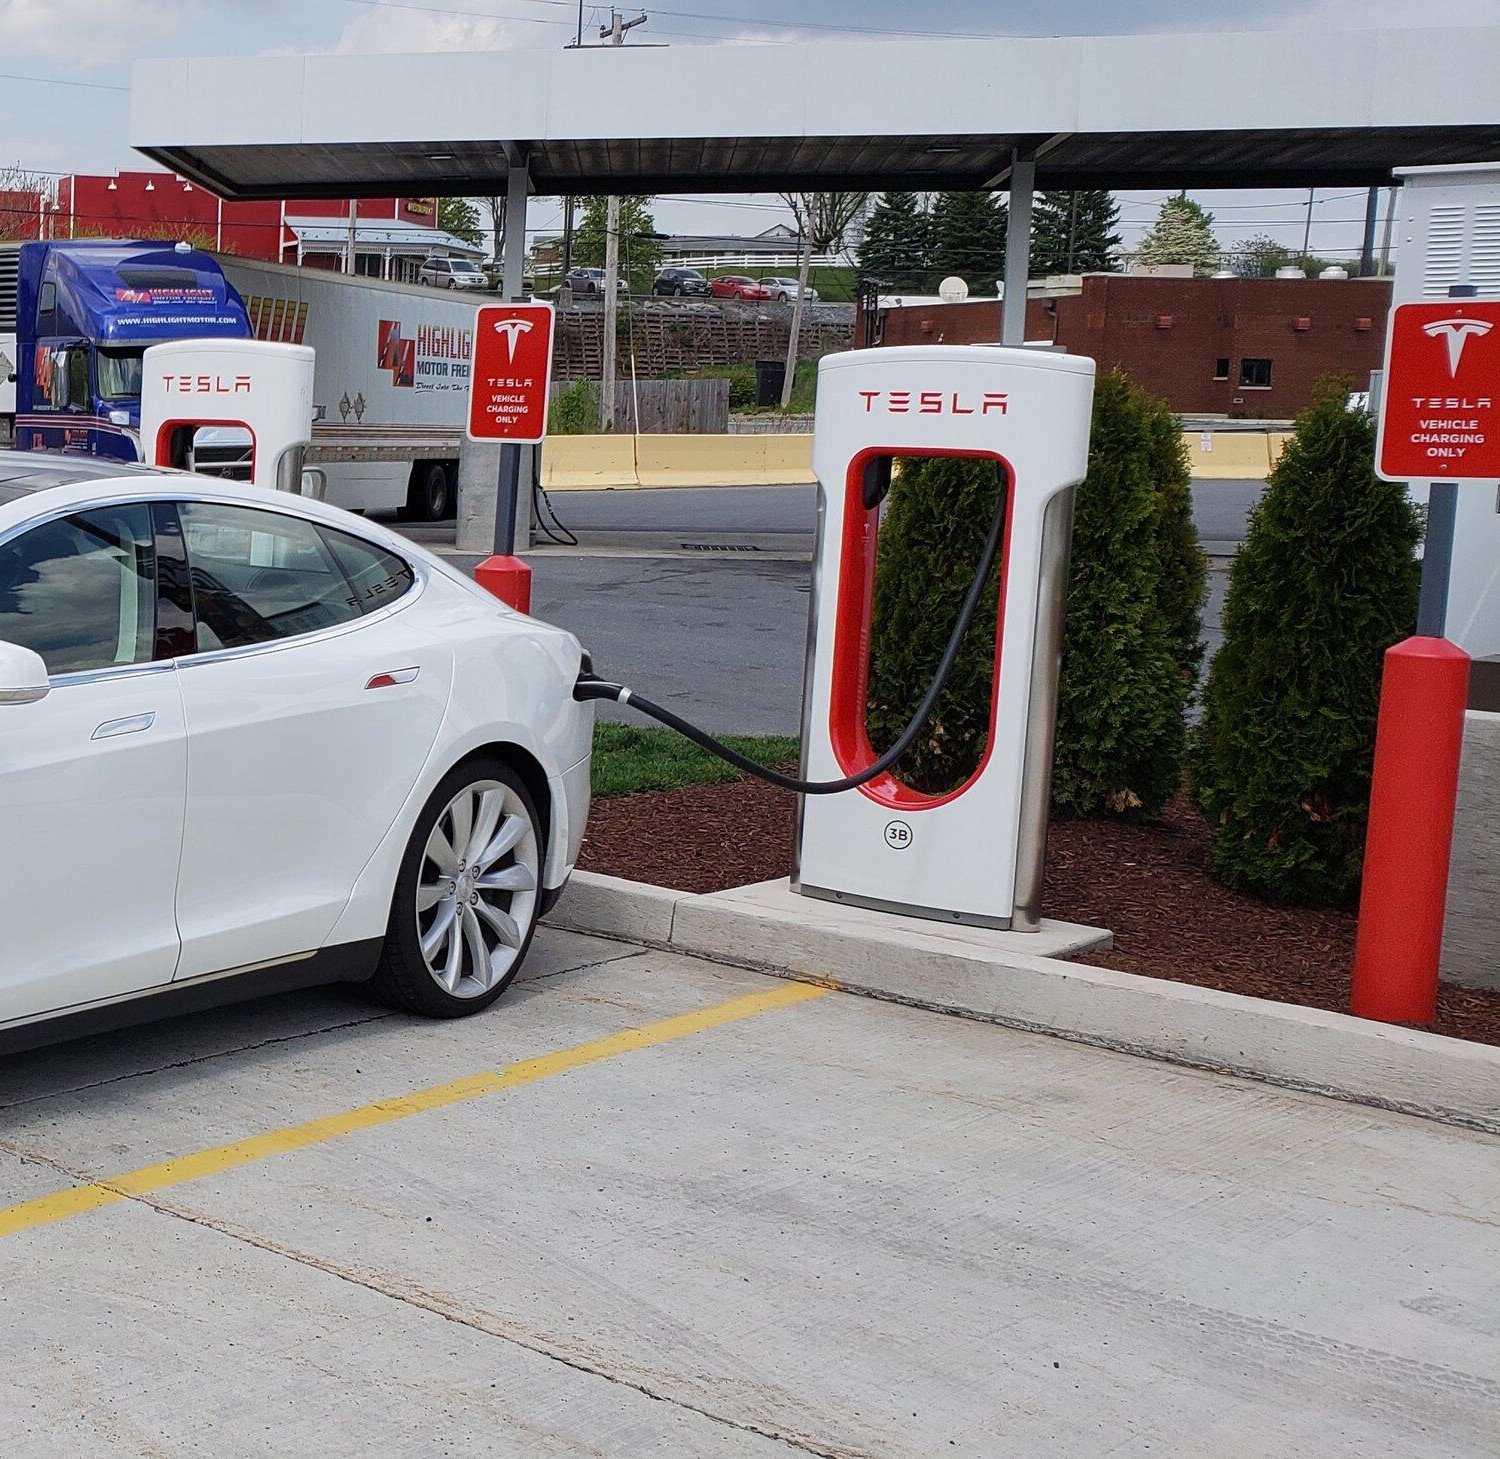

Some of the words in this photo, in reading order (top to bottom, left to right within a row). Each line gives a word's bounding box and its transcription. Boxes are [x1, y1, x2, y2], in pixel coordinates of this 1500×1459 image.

[117, 316, 237, 325] WWW.HIGHLIGHTMOTOR.COM
[417, 324, 473, 360] HIGHLIG
[416, 361, 448, 376] MOTOR
[451, 363, 471, 378] FREI
[163, 375, 251, 393] TESLA
[487, 378, 532, 387] TESLA
[491, 394, 525, 403] VEHICLE
[858, 391, 1009, 415] TESLA
[1411, 398, 1492, 409] TESLA
[486, 405, 529, 414] CHARGING
[495, 415, 519, 424] ONLY
[1419, 419, 1479, 430] VEHICLE
[1410, 433, 1485, 444] CHARGING
[1426, 447, 1467, 457] ONLY
[889, 828, 908, 841] 3B
